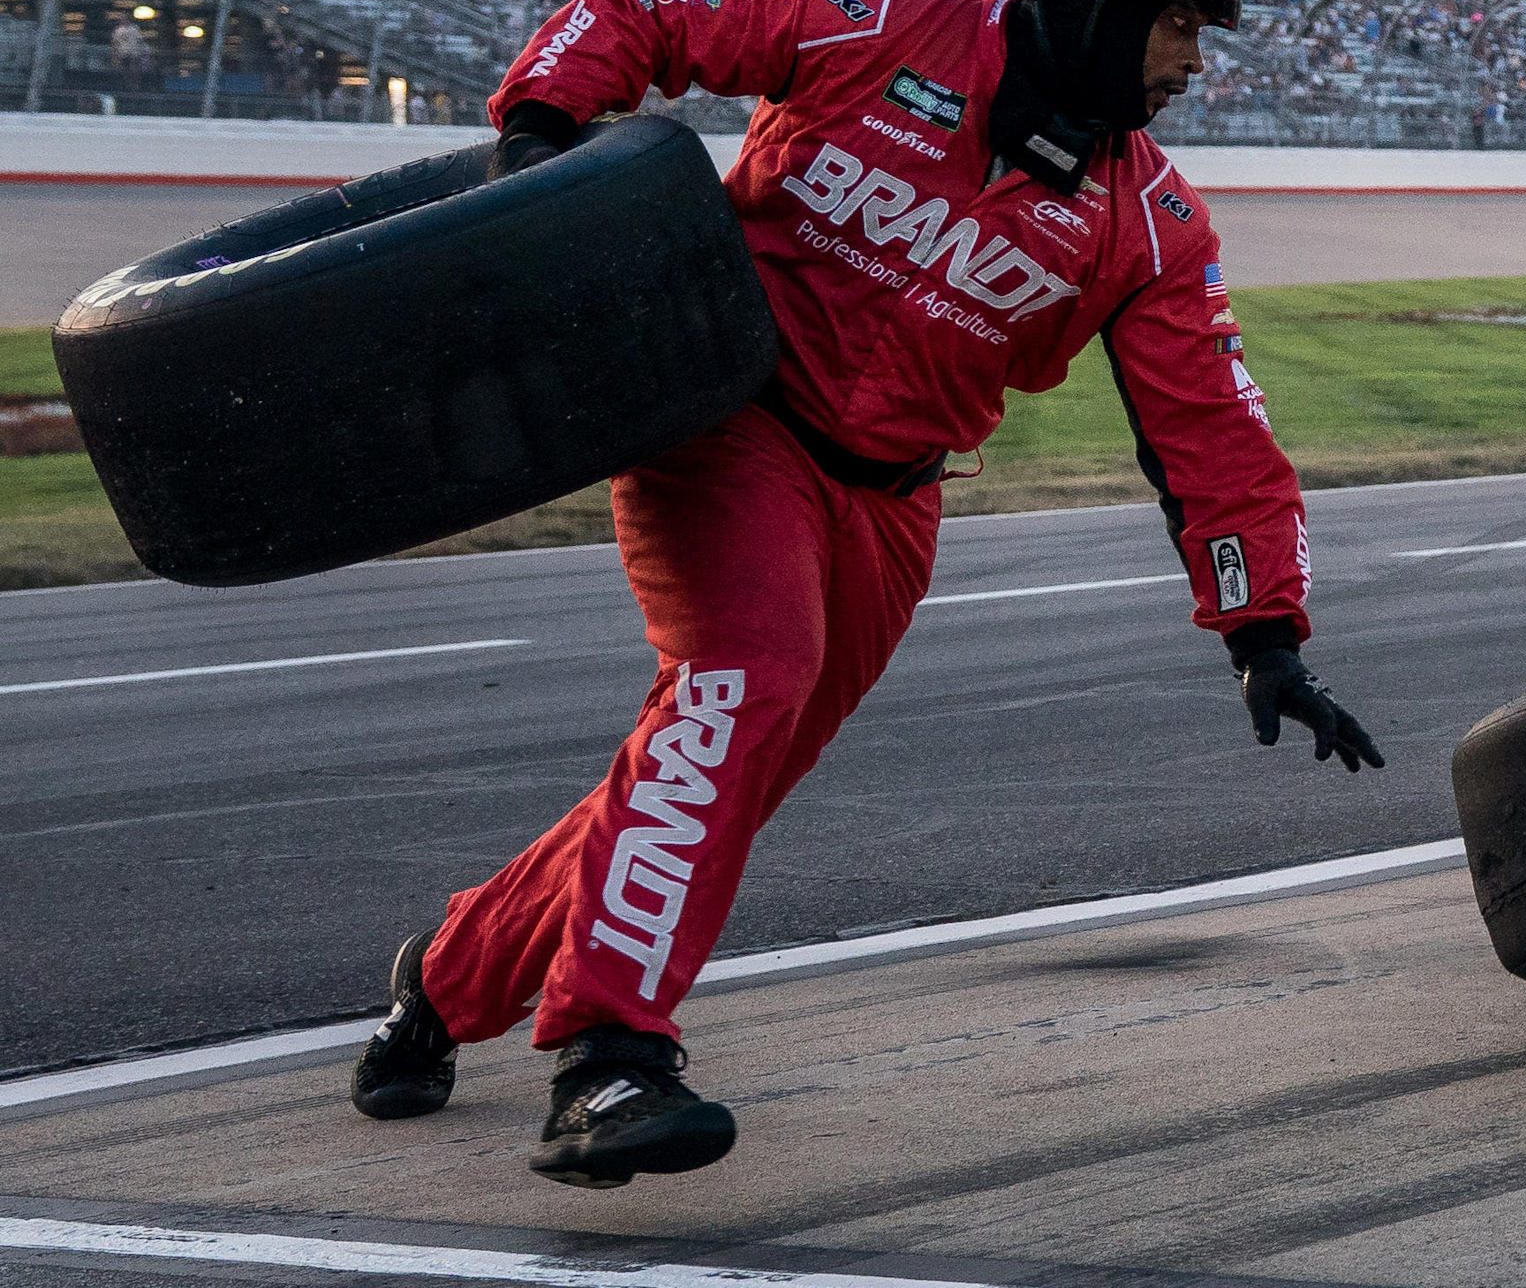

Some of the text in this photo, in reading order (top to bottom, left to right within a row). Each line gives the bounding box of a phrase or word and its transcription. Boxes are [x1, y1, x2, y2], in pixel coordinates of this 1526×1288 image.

[862, 114, 947, 162] GOODYEAR
[781, 142, 1081, 323] BRANDT
[915, 291, 1008, 345] Agiculture
[592, 662, 746, 1001] BRANDT
